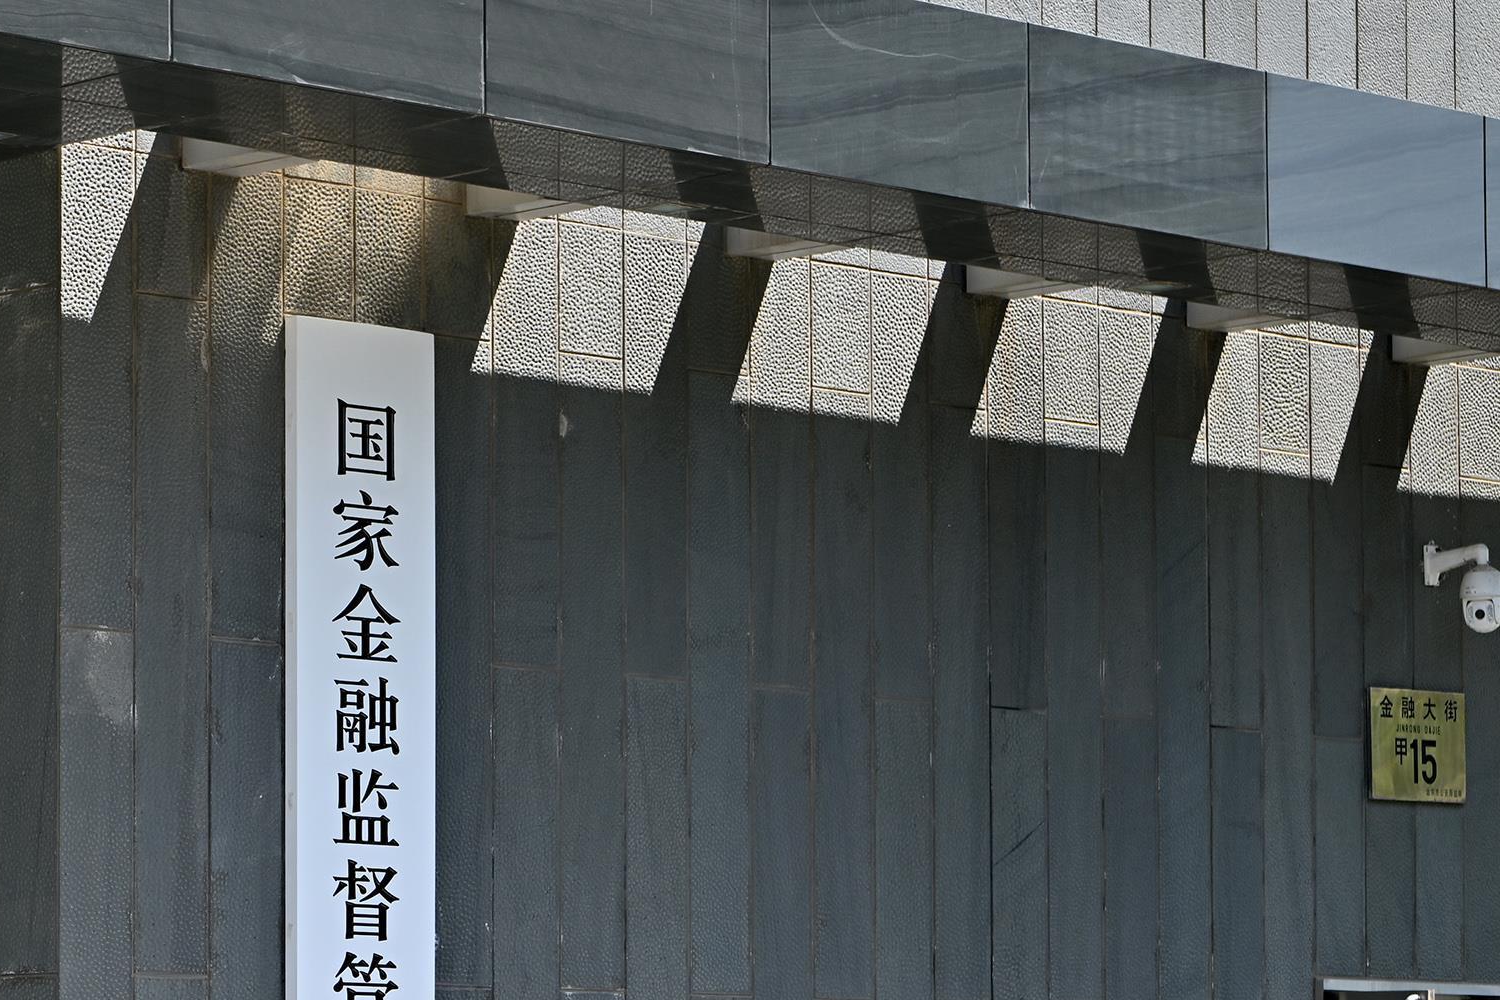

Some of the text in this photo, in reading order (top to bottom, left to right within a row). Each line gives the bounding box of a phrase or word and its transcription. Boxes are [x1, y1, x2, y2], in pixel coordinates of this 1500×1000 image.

[1380, 695, 1458, 722] 金融大街
[1396, 724, 1441, 736] JINRONG DAJIE
